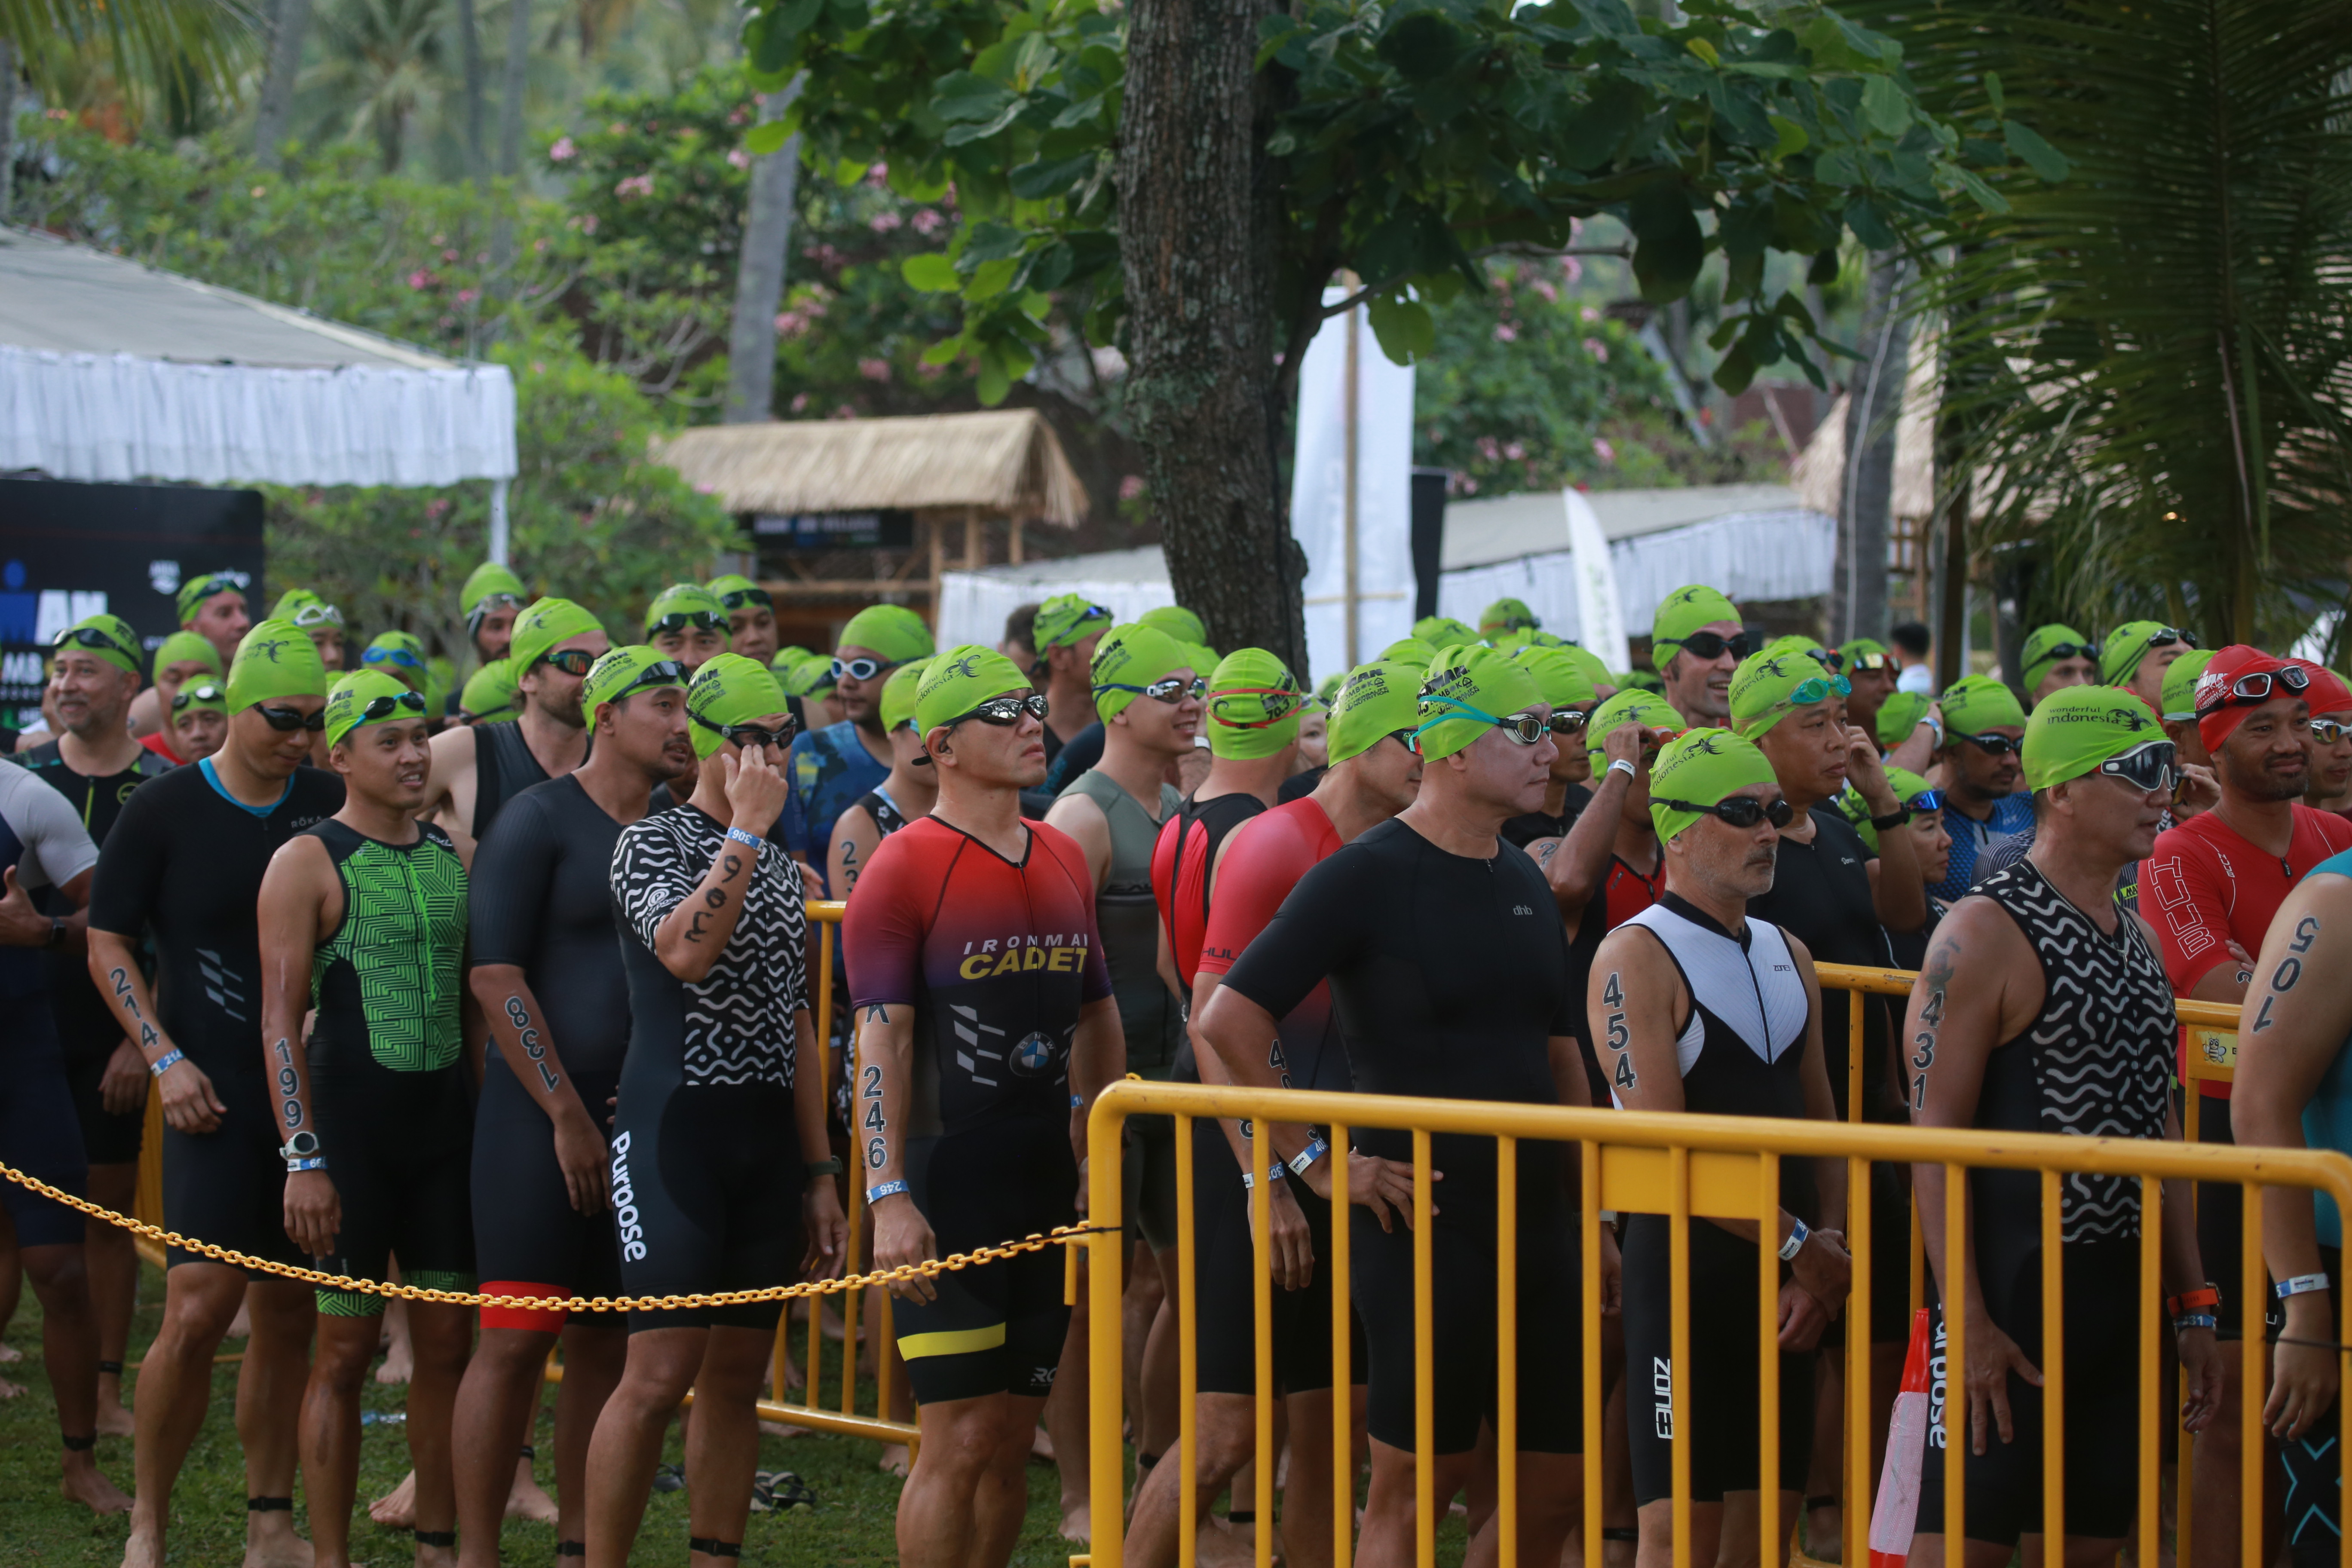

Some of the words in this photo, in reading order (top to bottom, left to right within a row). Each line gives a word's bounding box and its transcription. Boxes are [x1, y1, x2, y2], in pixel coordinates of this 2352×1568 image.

[2047, 712, 2121, 725] indonesia
[732, 829, 753, 844] 306
[2126, 886, 2138, 897] MA
[2217, 853, 2235, 878] HUUB
[1513, 905, 1533, 916] dhb
[2148, 856, 2215, 960] HUUB
[959, 946, 1087, 980] CADET
[109, 967, 159, 1048] 214
[1602, 972, 1637, 1090] 454
[505, 996, 558, 1092] 138
[1912, 991, 1945, 1112] 431
[275, 1037, 303, 1129] 199
[862, 1065, 888, 1170] 246
[880, 1181, 902, 1196] 246
